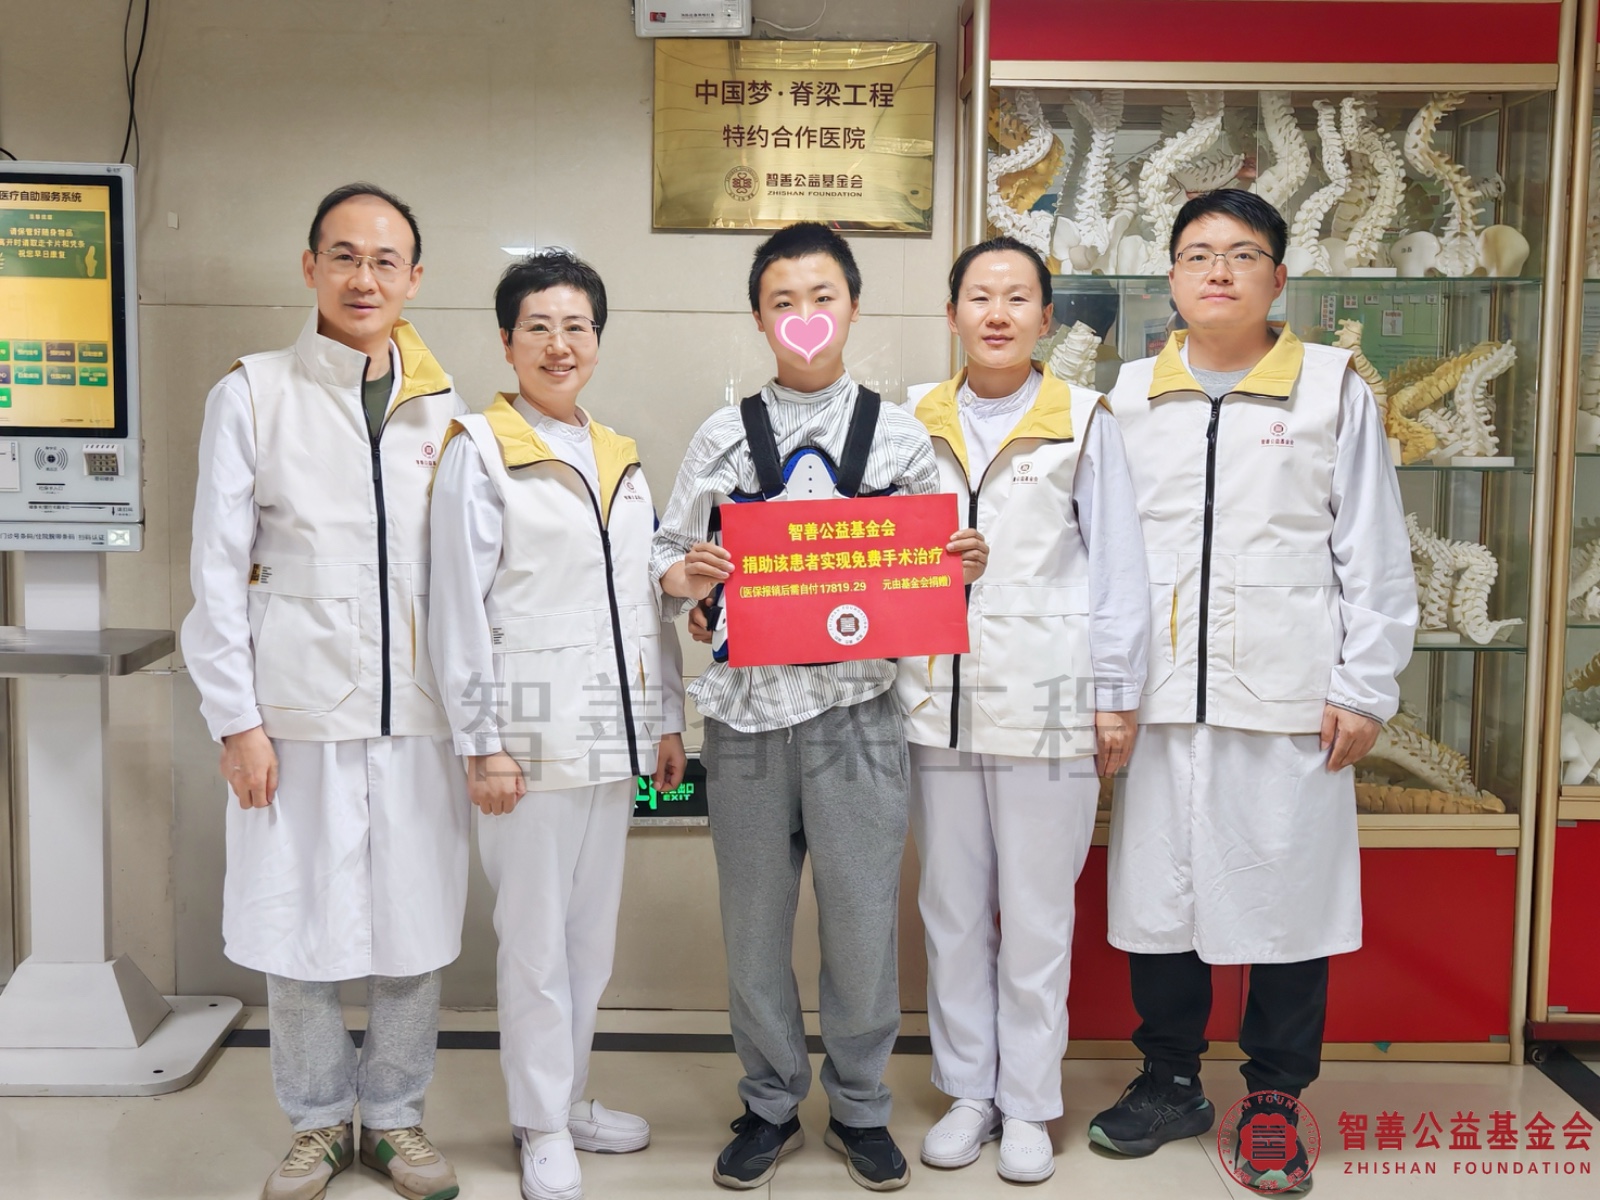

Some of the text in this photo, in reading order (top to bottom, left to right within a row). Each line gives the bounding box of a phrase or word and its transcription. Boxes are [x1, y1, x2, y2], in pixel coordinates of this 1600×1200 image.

[695, 79, 894, 108] 中国梦·脊梁工程
[722, 124, 866, 150] 特约合作医院
[766, 173, 863, 189] 智善公益基金会
[788, 519, 896, 541] 智善公益基金会
[742, 546, 944, 575] 捐助该患者实现免费手术治疗
